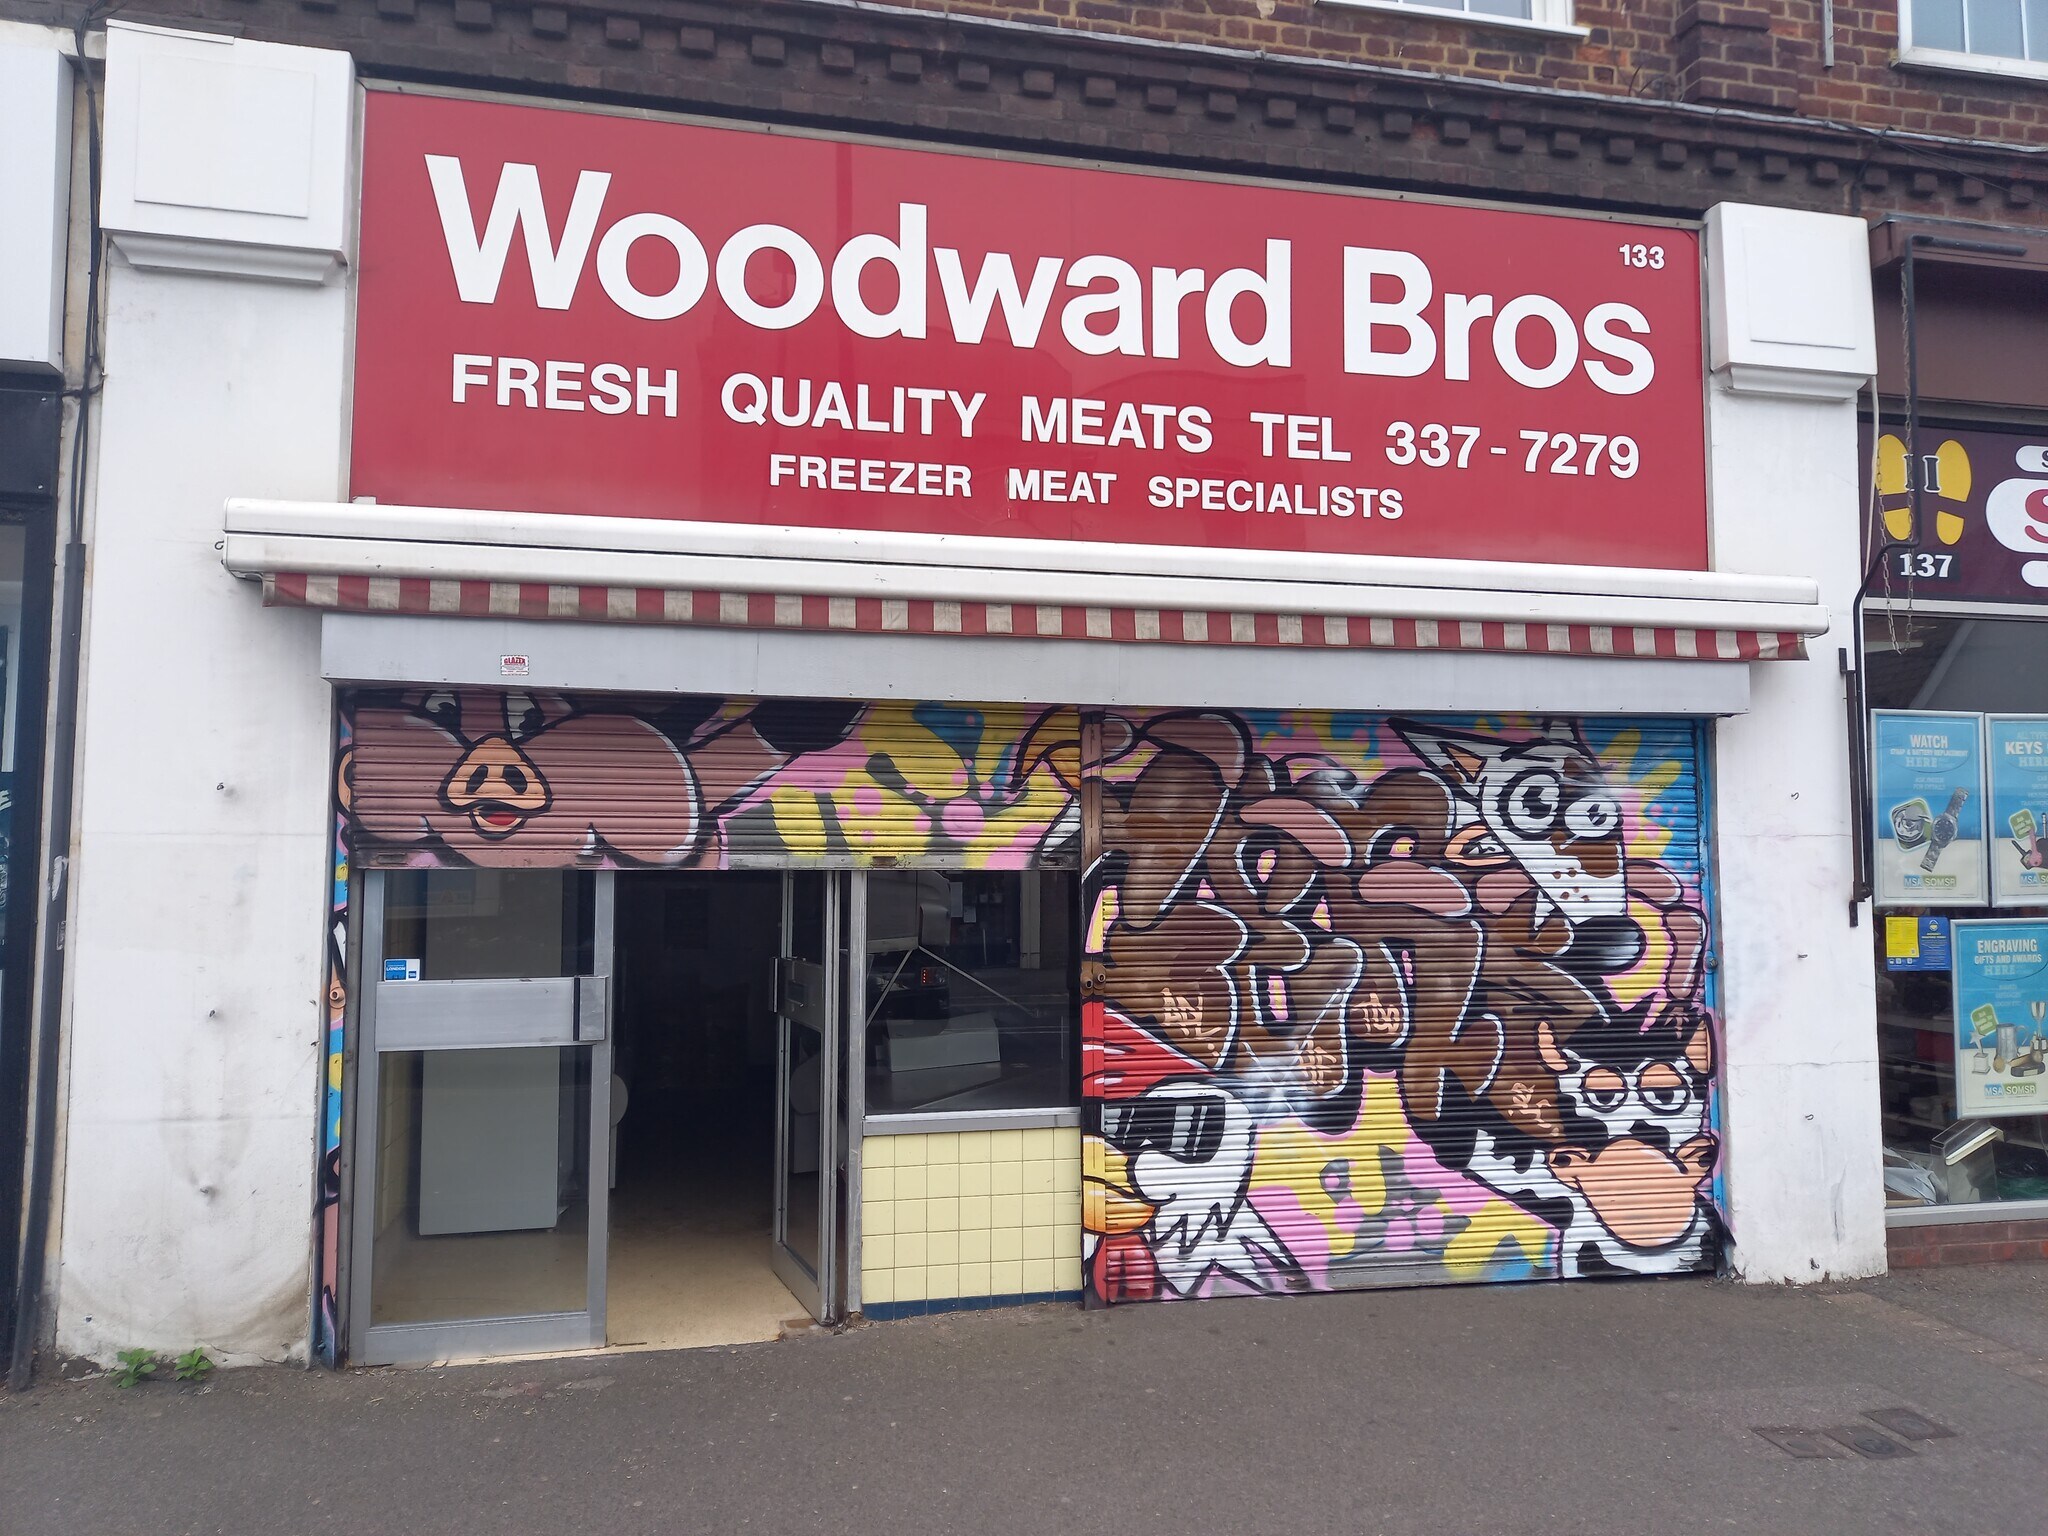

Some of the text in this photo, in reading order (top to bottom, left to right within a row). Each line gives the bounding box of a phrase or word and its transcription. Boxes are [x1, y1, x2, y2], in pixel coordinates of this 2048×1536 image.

[1619, 243, 1665, 270] 133
[424, 153, 1656, 395] Woodward Bros
[452, 353, 678, 418] FRESH
[721, 372, 987, 438] QUALITY
[1021, 395, 1213, 453] MEATS
[1250, 411, 1352, 462] TEL
[770, 453, 1404, 520] FREEZER MEAT SPECIALISTS
[1898, 553, 1953, 578] 137
[1910, 735, 1948, 749] WATCH
[2005, 741, 2043, 755] KEYS
[1905, 756, 1938, 768] HERE
[1977, 939, 2038, 954] ENGRAVING
[1974, 954, 2042, 965] GIFTS AND AWARDS
[1984, 965, 2016, 976] HERE
[1985, 1085, 2036, 1096] MSA SOMSR
